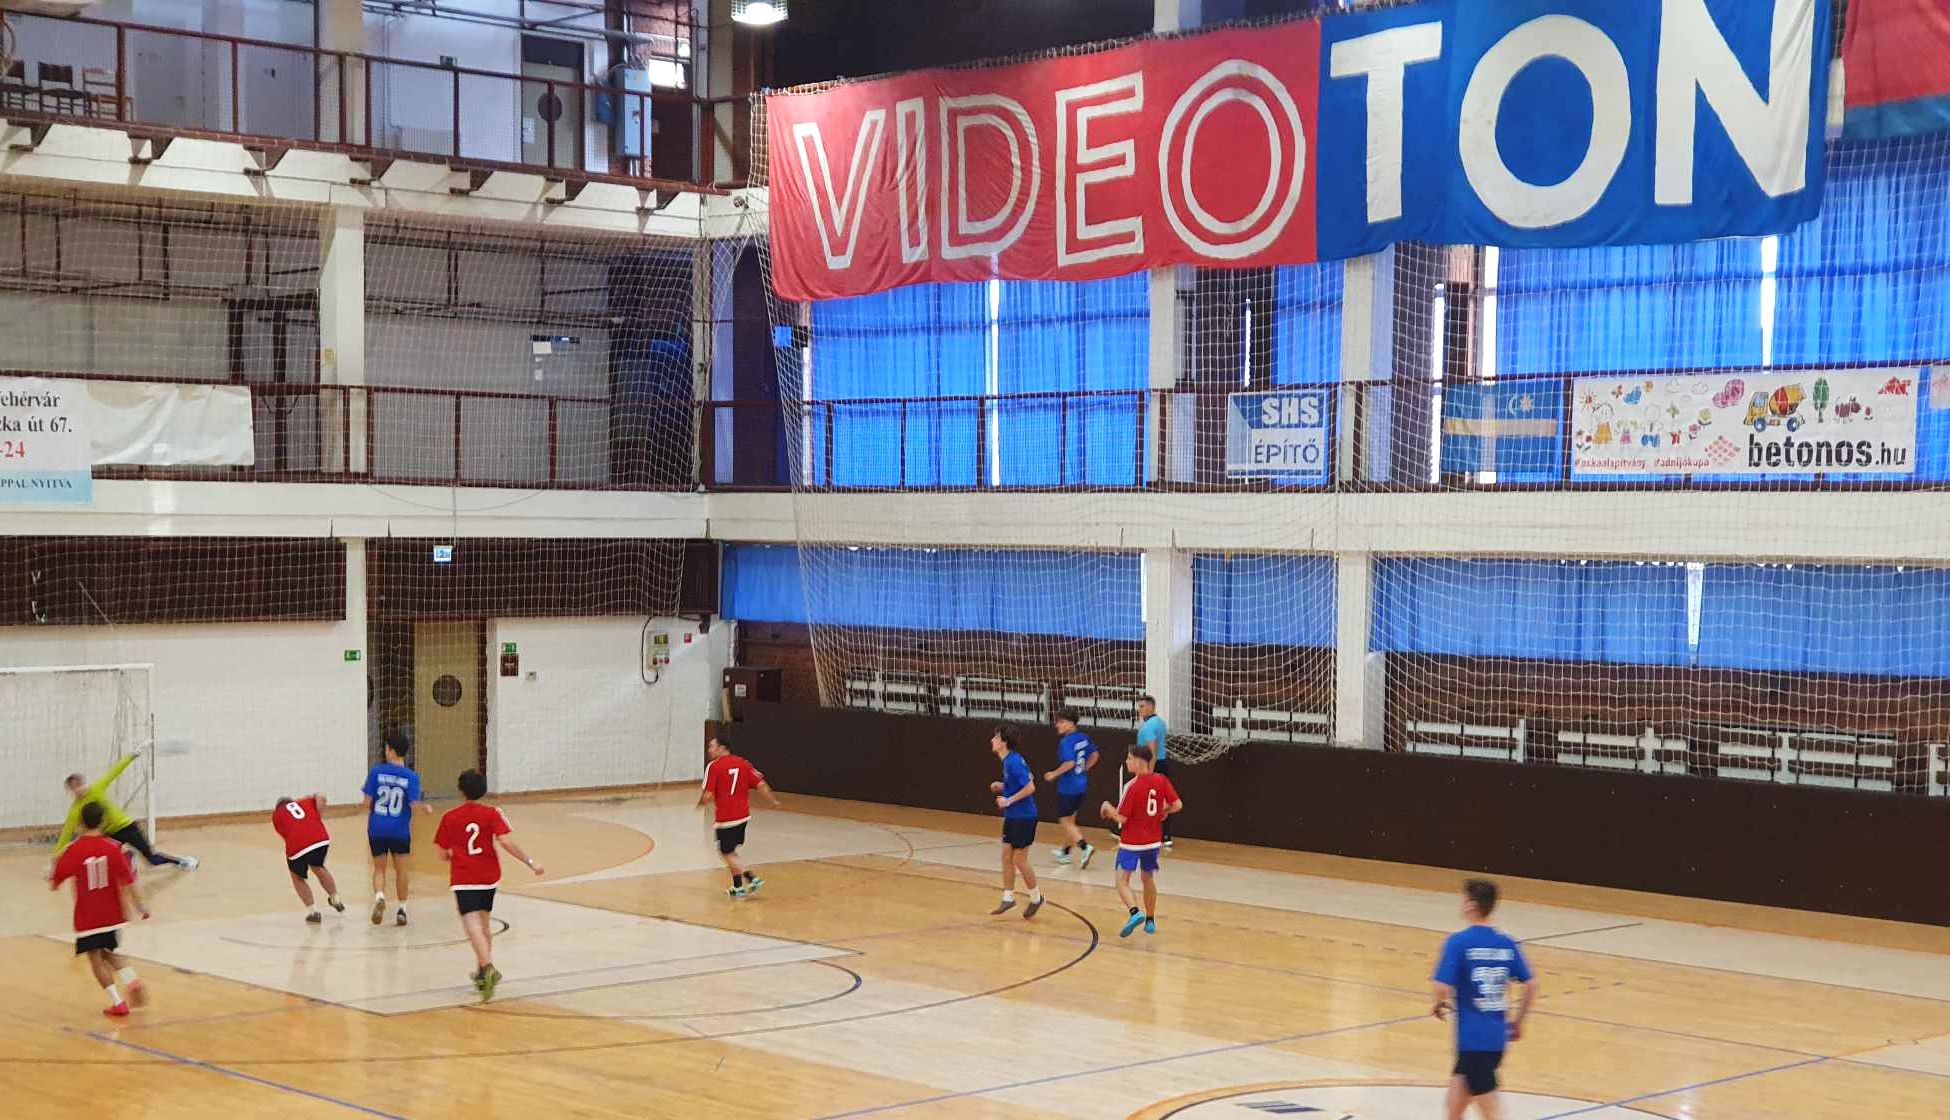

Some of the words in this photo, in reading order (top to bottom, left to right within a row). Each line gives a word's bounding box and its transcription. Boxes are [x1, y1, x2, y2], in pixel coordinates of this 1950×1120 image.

[28, 416, 44, 432] út
[50, 417, 72, 432] 67.
[1262, 397, 1320, 425] SHS
[1254, 438, 1320, 464] ÉPÍTŐ
[1748, 433, 1907, 467] betonos.hu
[30, 479, 72, 488] NYITVA
[728, 767, 740, 796] 7
[286, 801, 306, 820] 8
[374, 785, 405, 817] 20
[1147, 788, 1158, 816] 6
[465, 822, 483, 855] 2
[84, 855, 109, 890] 11
